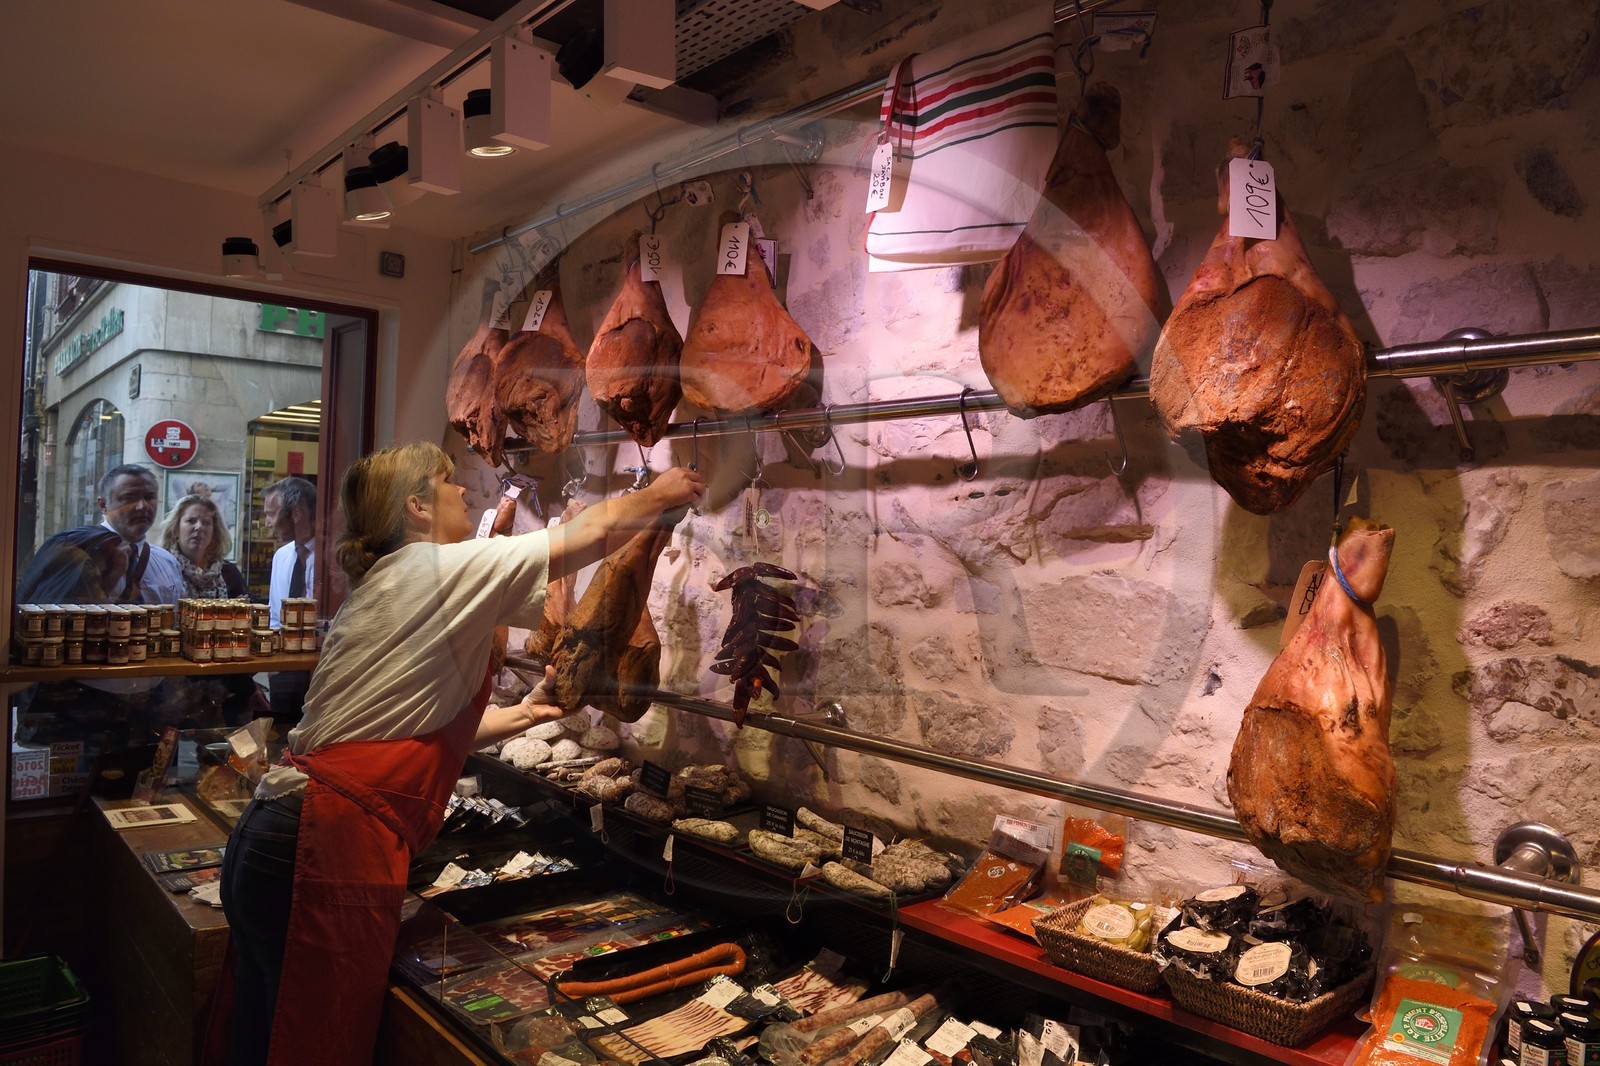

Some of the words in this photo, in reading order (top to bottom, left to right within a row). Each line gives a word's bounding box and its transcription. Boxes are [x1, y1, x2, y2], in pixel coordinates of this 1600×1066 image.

[878, 164, 887, 200] JAMBON
[645, 239, 663, 275] 105€
[724, 235, 741, 273] 110€
[51, 743, 81, 752] Ticket
[848, 828, 869, 840] SAUCISSON
[850, 837, 870, 849] MONTAGNE
[1402, 1007, 1428, 1023] PIMENT
[1423, 1008, 1448, 1043] D'ESPELETTE
